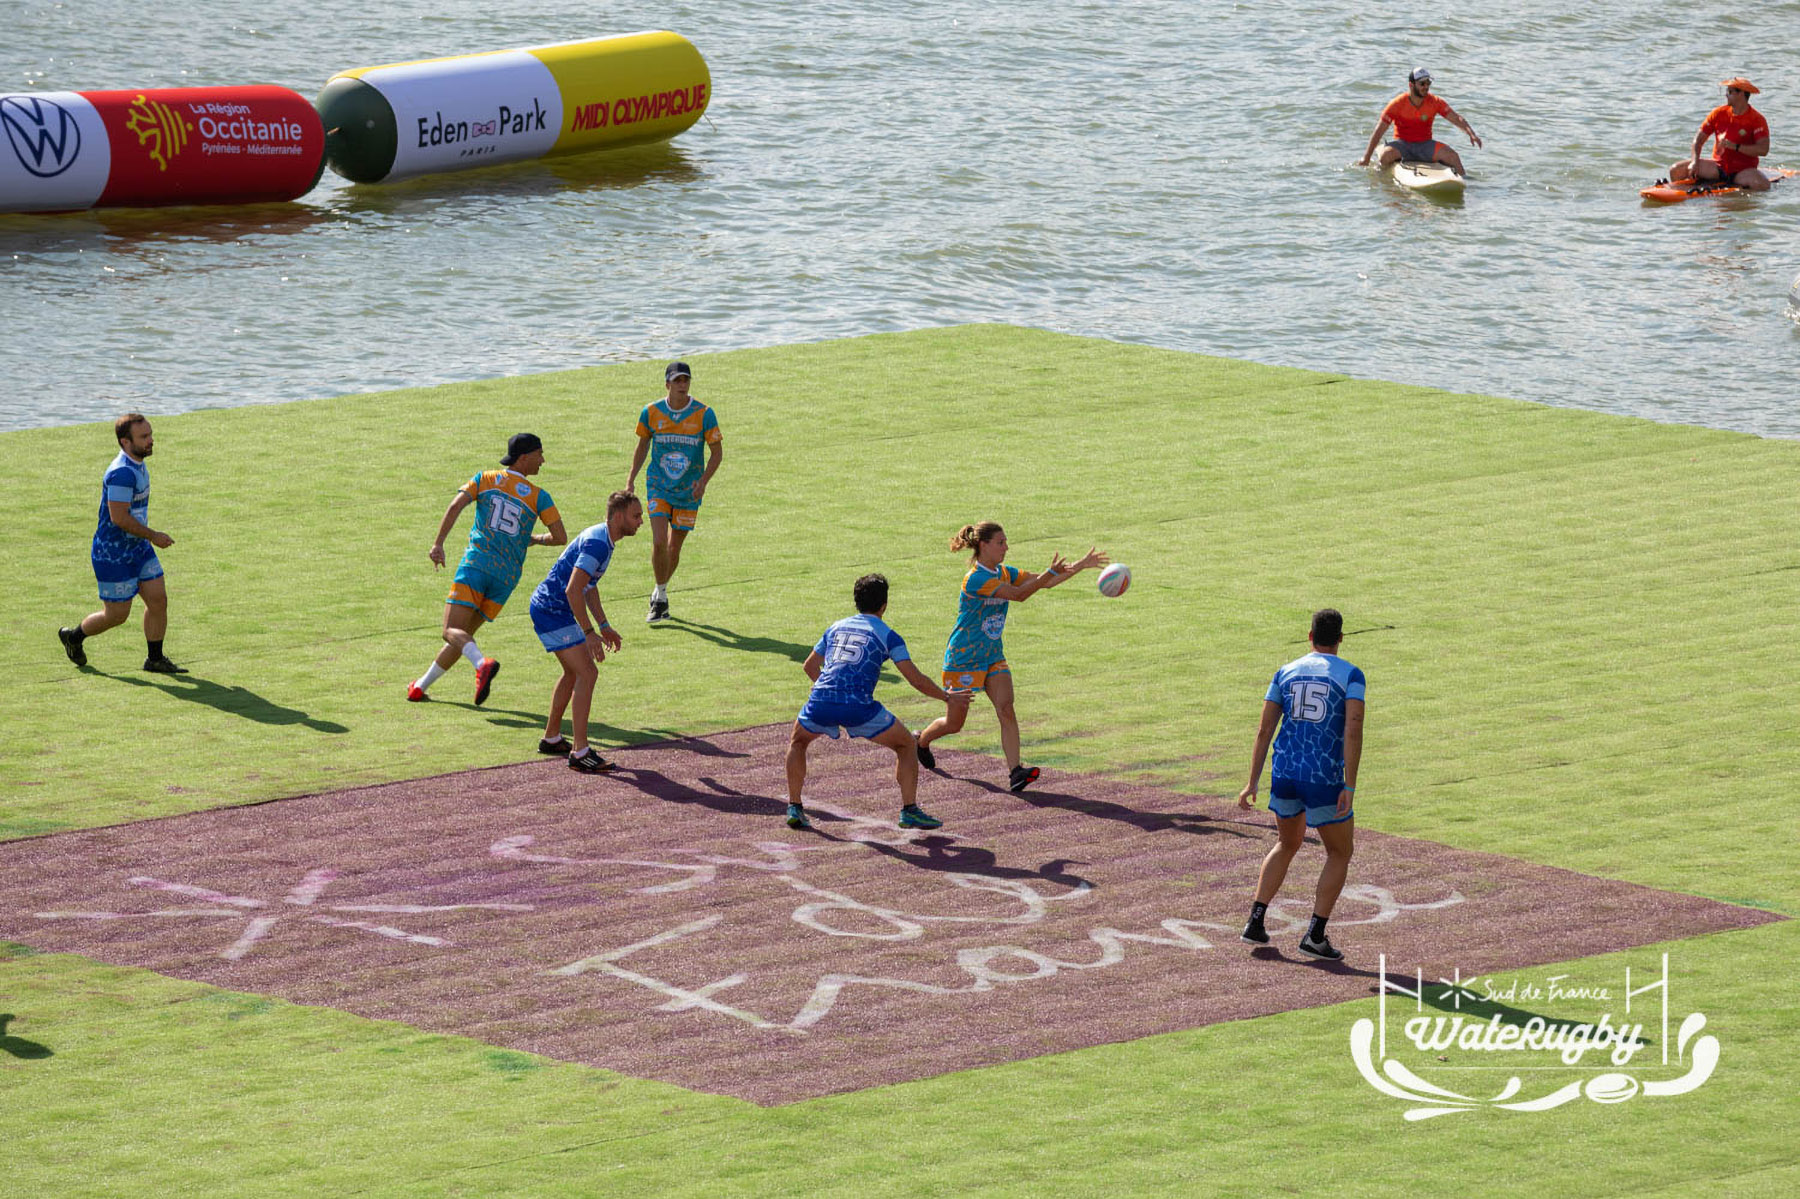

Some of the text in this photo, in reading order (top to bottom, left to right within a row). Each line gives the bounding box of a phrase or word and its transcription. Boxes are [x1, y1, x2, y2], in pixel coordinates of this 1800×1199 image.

[188, 102, 250, 117] La Région
[418, 97, 547, 148] Eden Park
[571, 84, 706, 132] MIDI OLYMPIQUE
[199, 117, 302, 141] Occitanie
[202, 142, 241, 156] Pyrénées
[247, 144, 303, 155] Méditerranée
[460, 145, 496, 157] PARIS
[489, 495, 522, 537] 15
[833, 631, 869, 665] 15
[1290, 681, 1330, 723] 15
